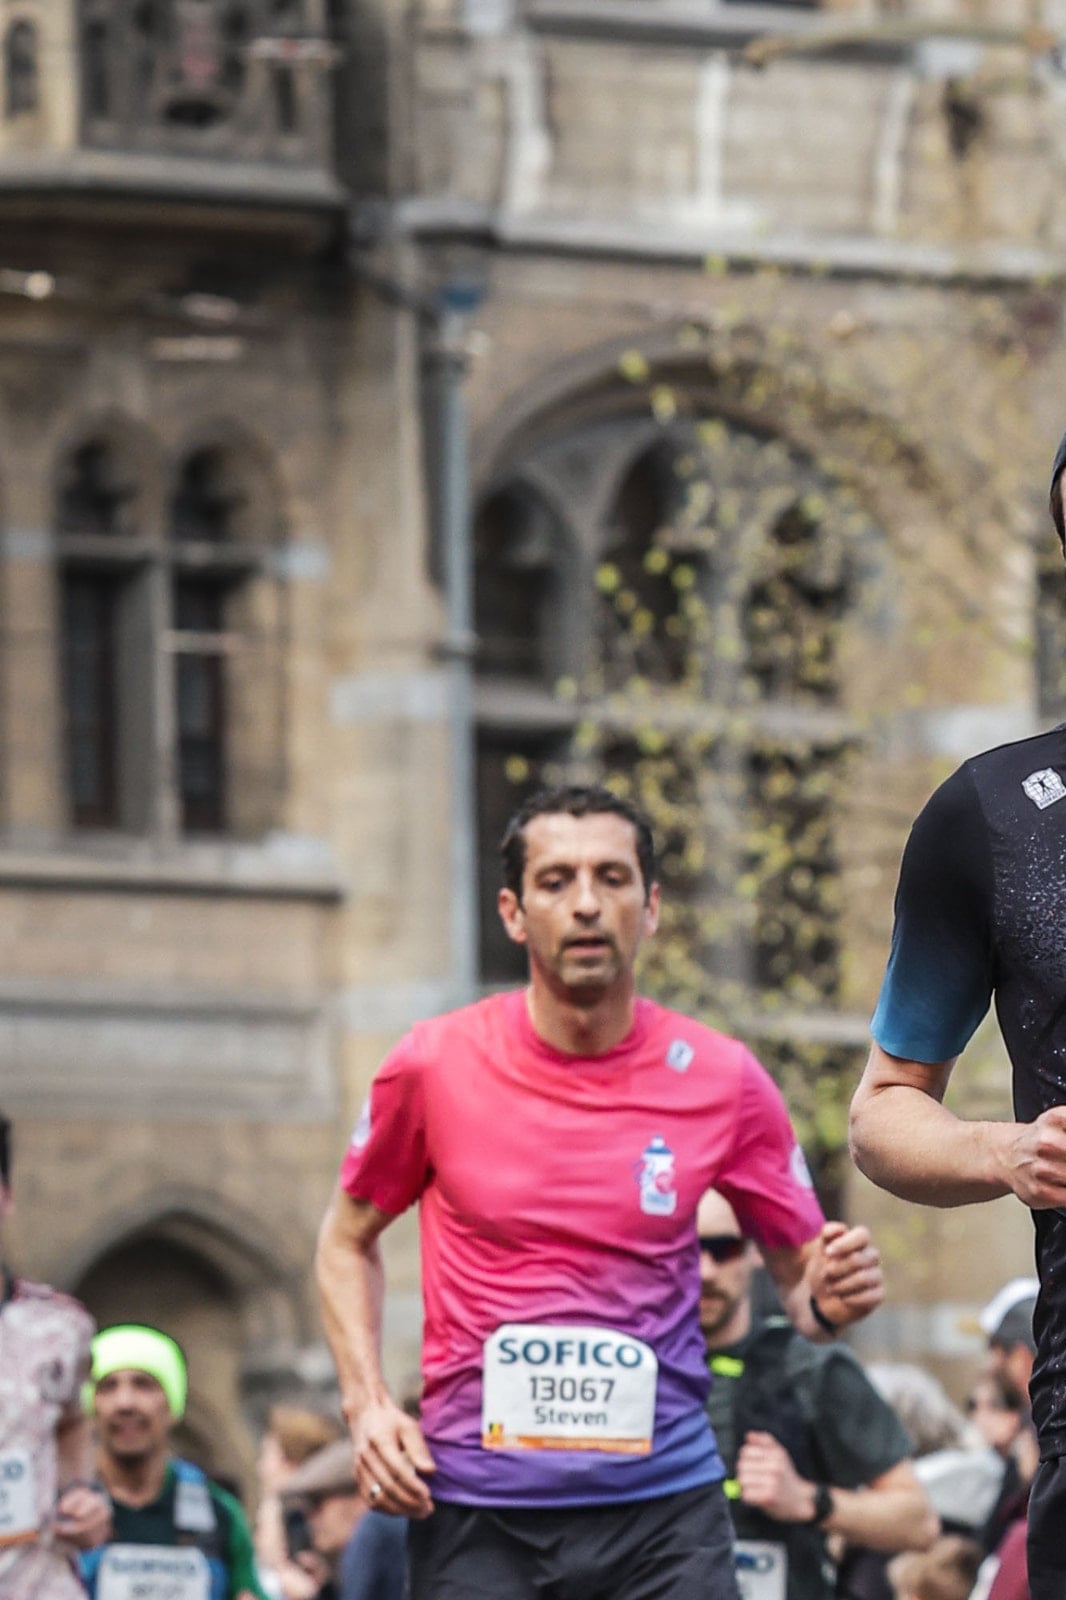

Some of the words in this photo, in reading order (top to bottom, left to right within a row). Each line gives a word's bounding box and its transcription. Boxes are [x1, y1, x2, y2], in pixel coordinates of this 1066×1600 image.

[498, 1338, 643, 1368] SOFICO
[529, 1376, 615, 1403] 13067
[534, 1405, 608, 1425] Steven
